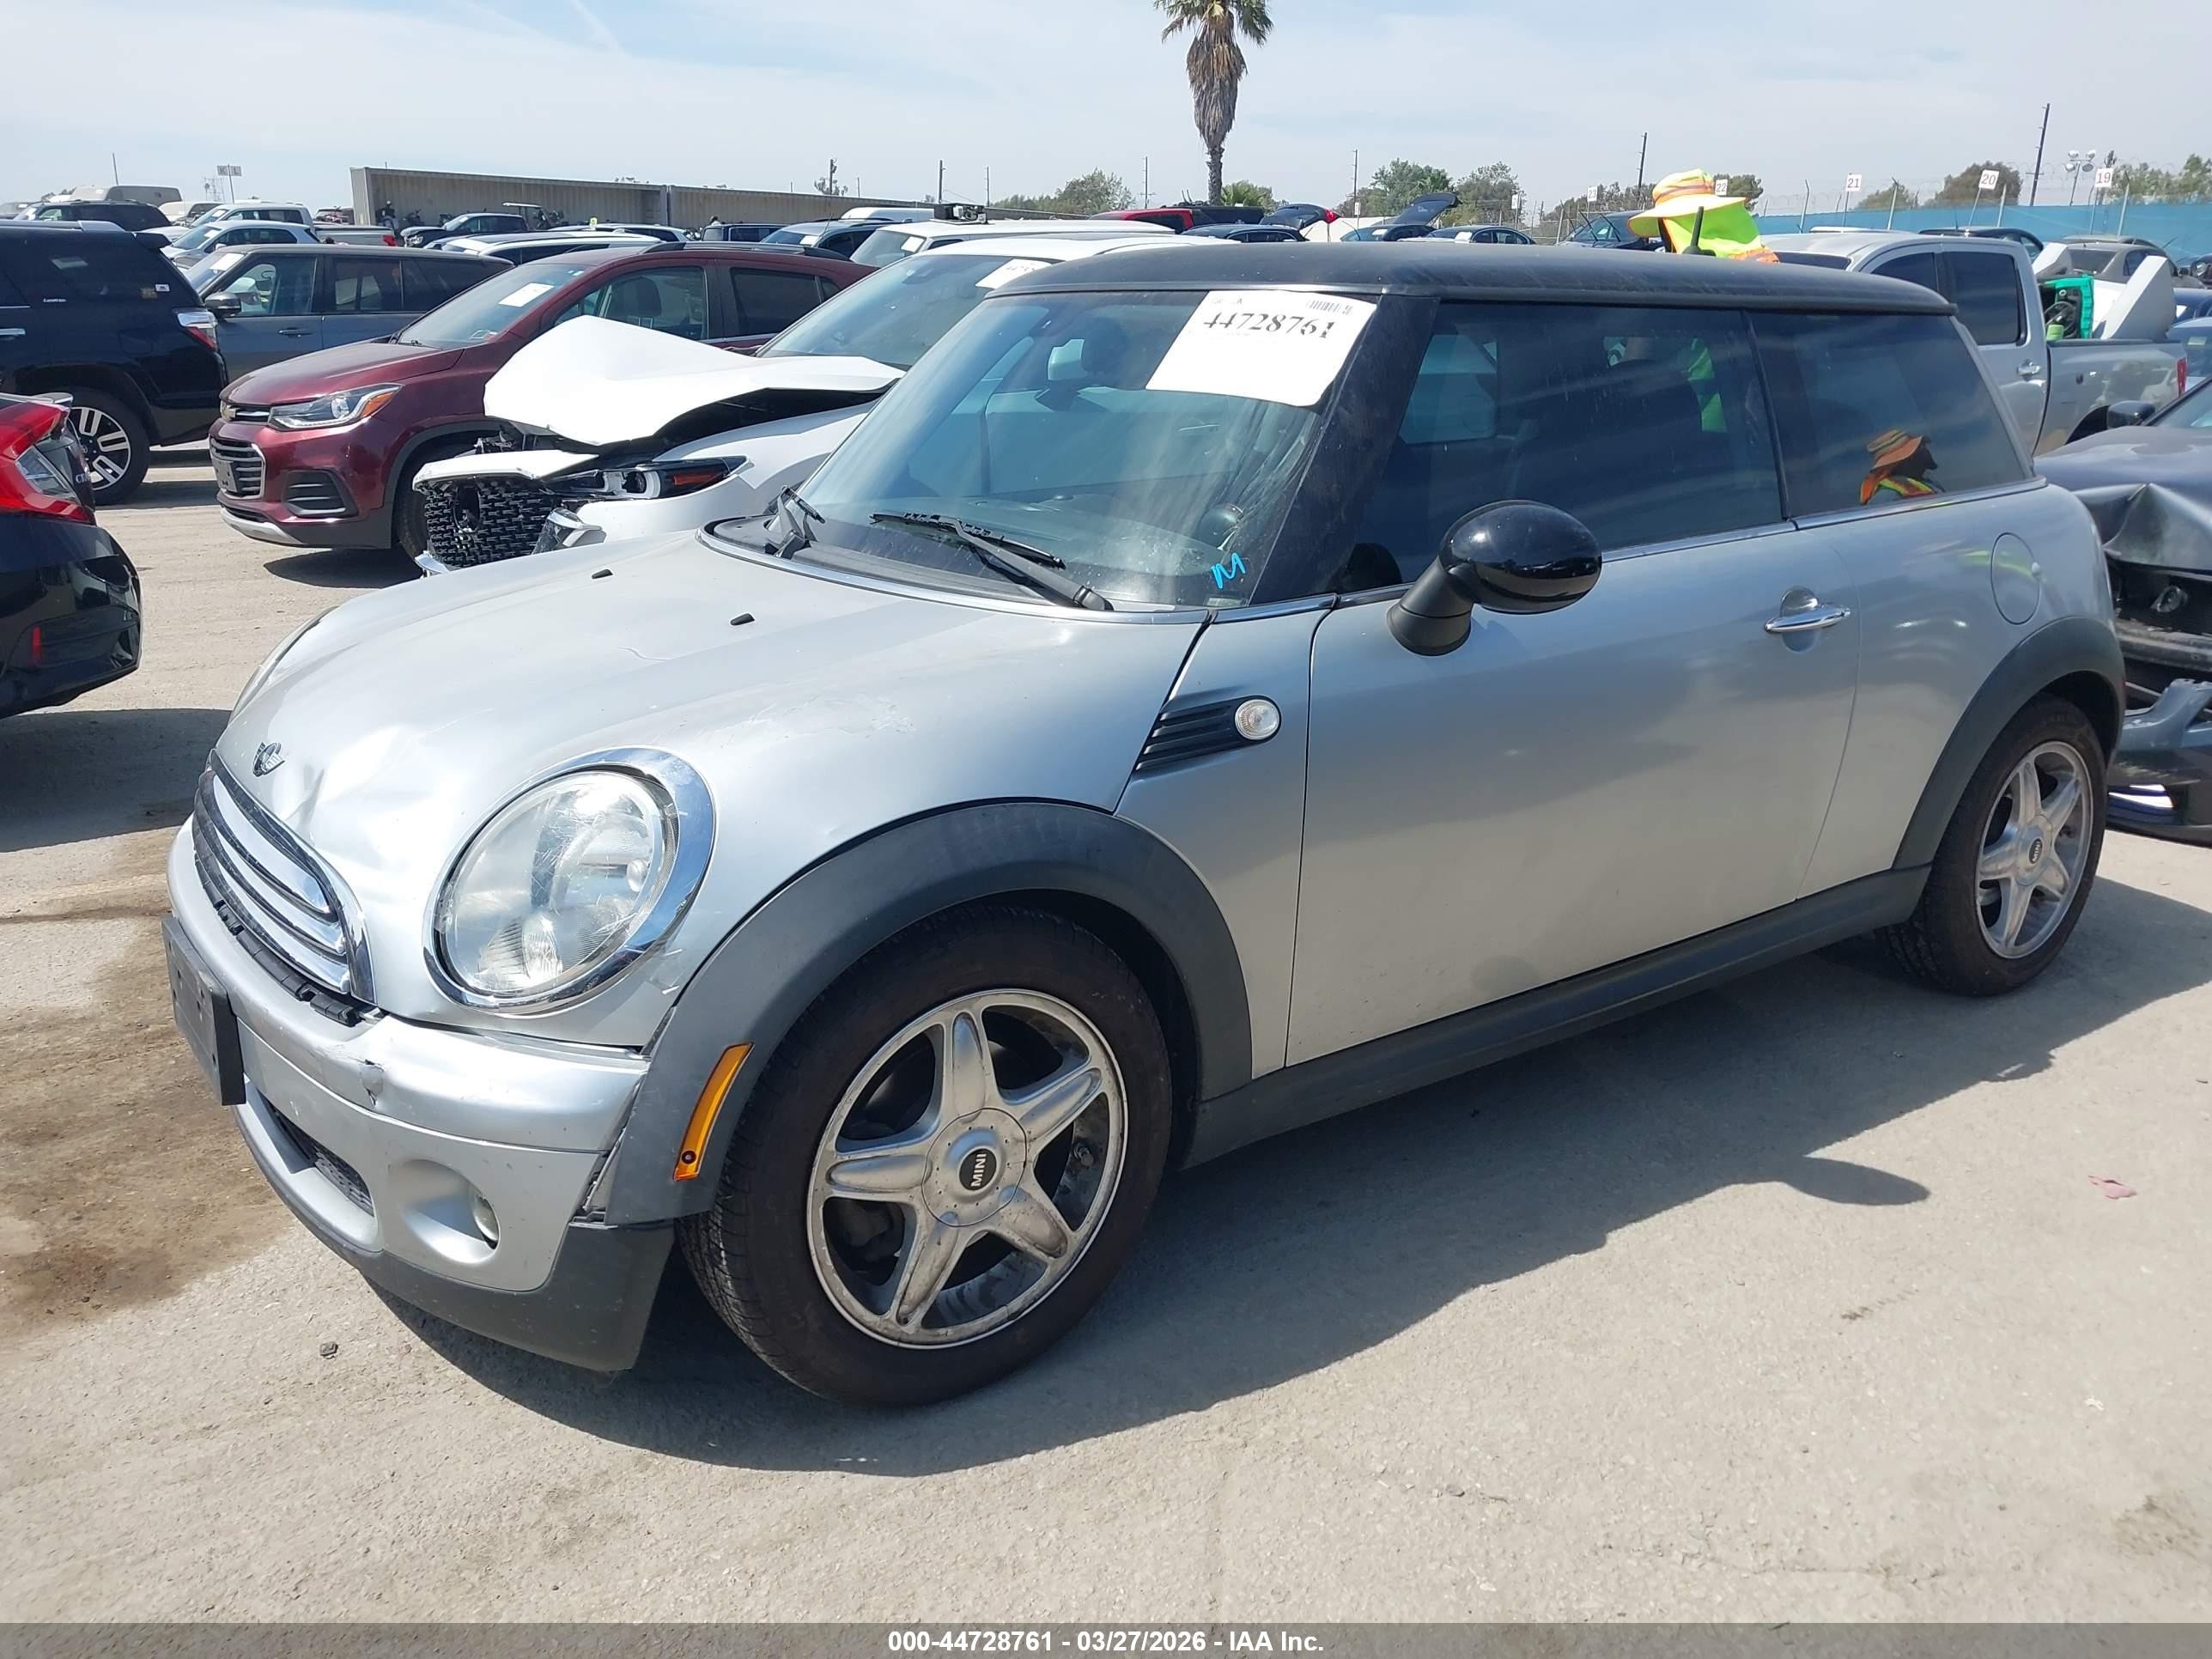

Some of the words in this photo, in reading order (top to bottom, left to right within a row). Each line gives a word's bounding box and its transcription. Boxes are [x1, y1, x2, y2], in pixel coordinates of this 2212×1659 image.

[1847, 178, 1859, 188] 21
[1981, 173, 1996, 185] 20
[2096, 172, 2111, 184] 19
[1717, 182, 1727, 193] 22
[1204, 312, 1334, 338] 44728761
[970, 1153, 987, 1187] MINI
